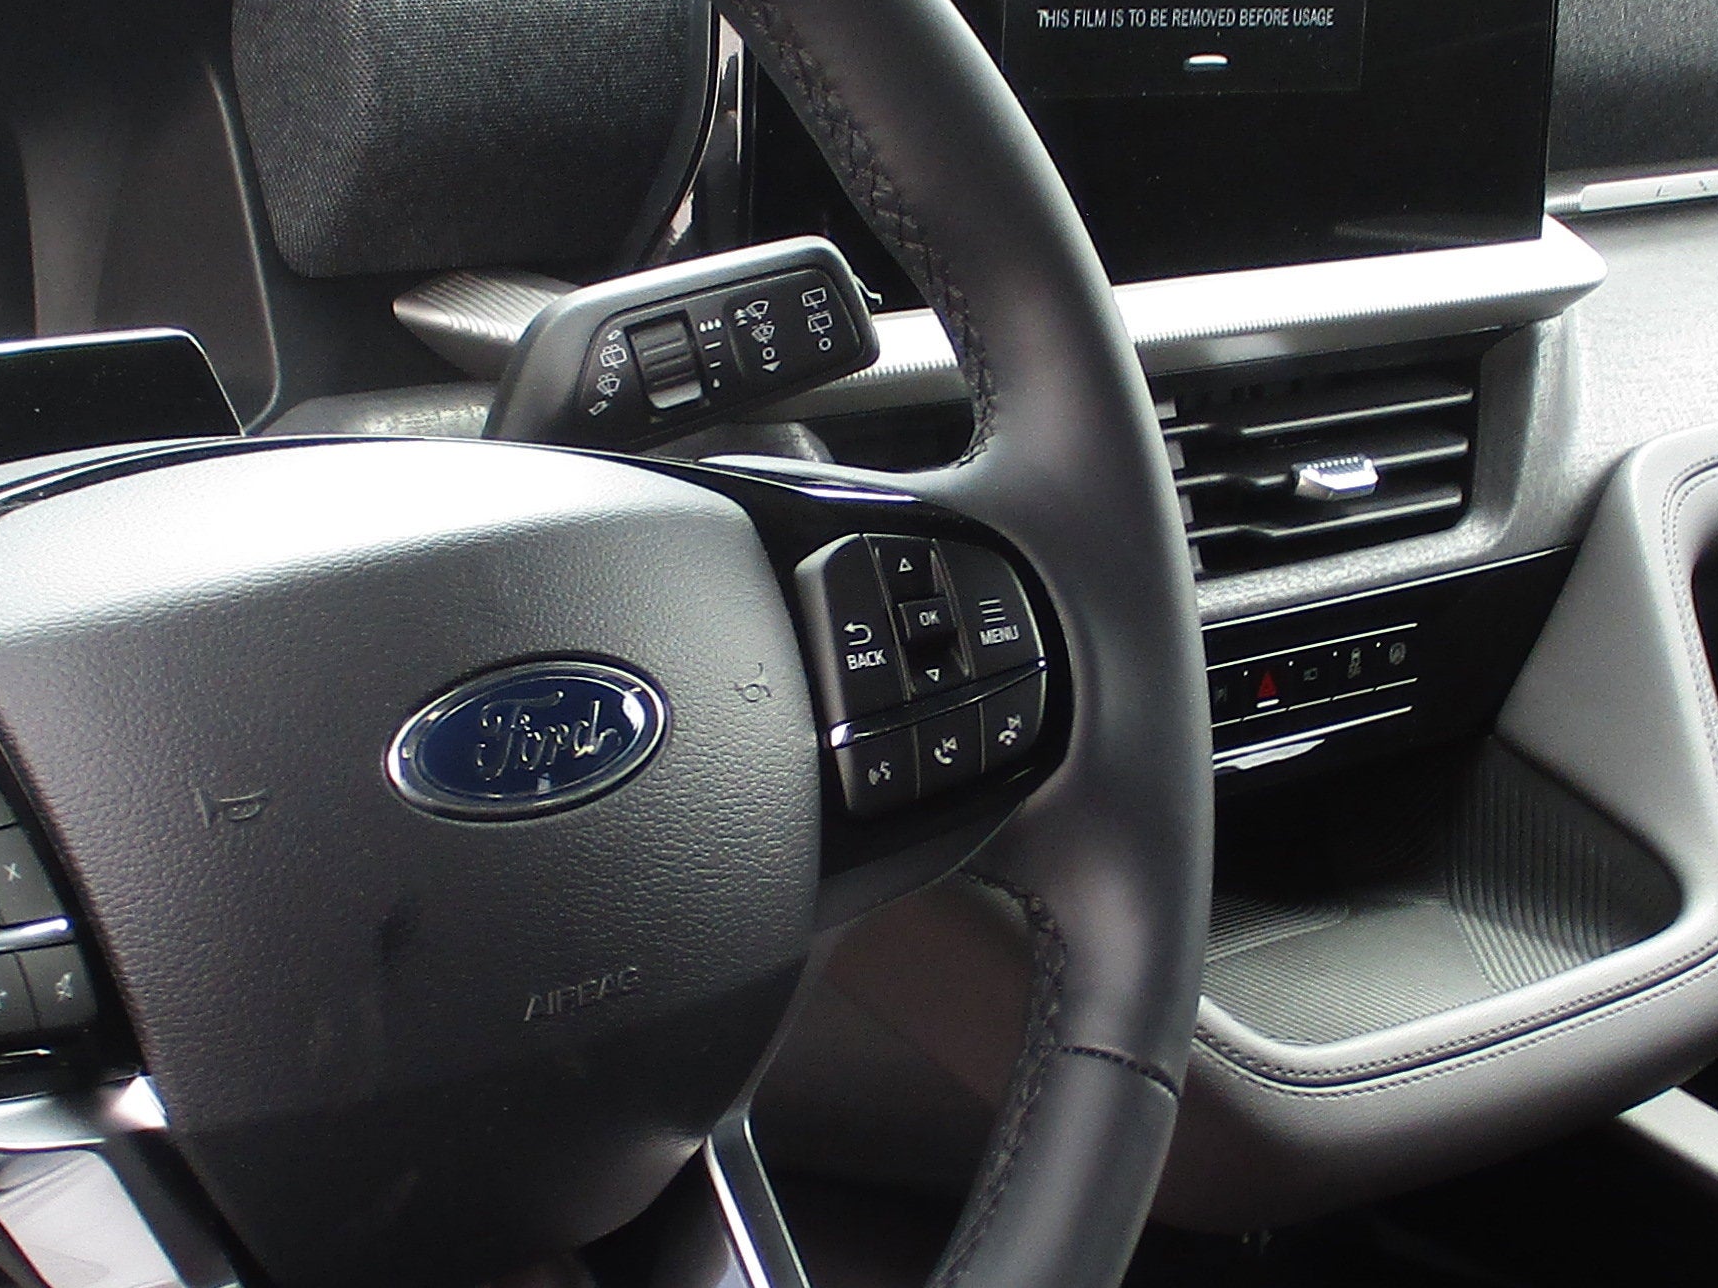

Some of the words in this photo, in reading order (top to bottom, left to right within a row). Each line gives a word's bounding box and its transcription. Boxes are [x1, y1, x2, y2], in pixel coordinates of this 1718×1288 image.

[1037, 9, 1070, 28] THIS
[1073, 9, 1107, 28] FILM
[1110, 9, 1125, 28] IS
[1128, 9, 1147, 28] TO
[1149, 9, 1169, 28] BE
[1171, 8, 1237, 28] REMOVED
[1239, 8, 1290, 28] BEFORE
[1292, 8, 1335, 28] USAGE
[918, 609, 941, 627] OK
[978, 624, 1021, 647] MENU
[845, 648, 889, 672] BACK
[475, 689, 624, 783] Ford
